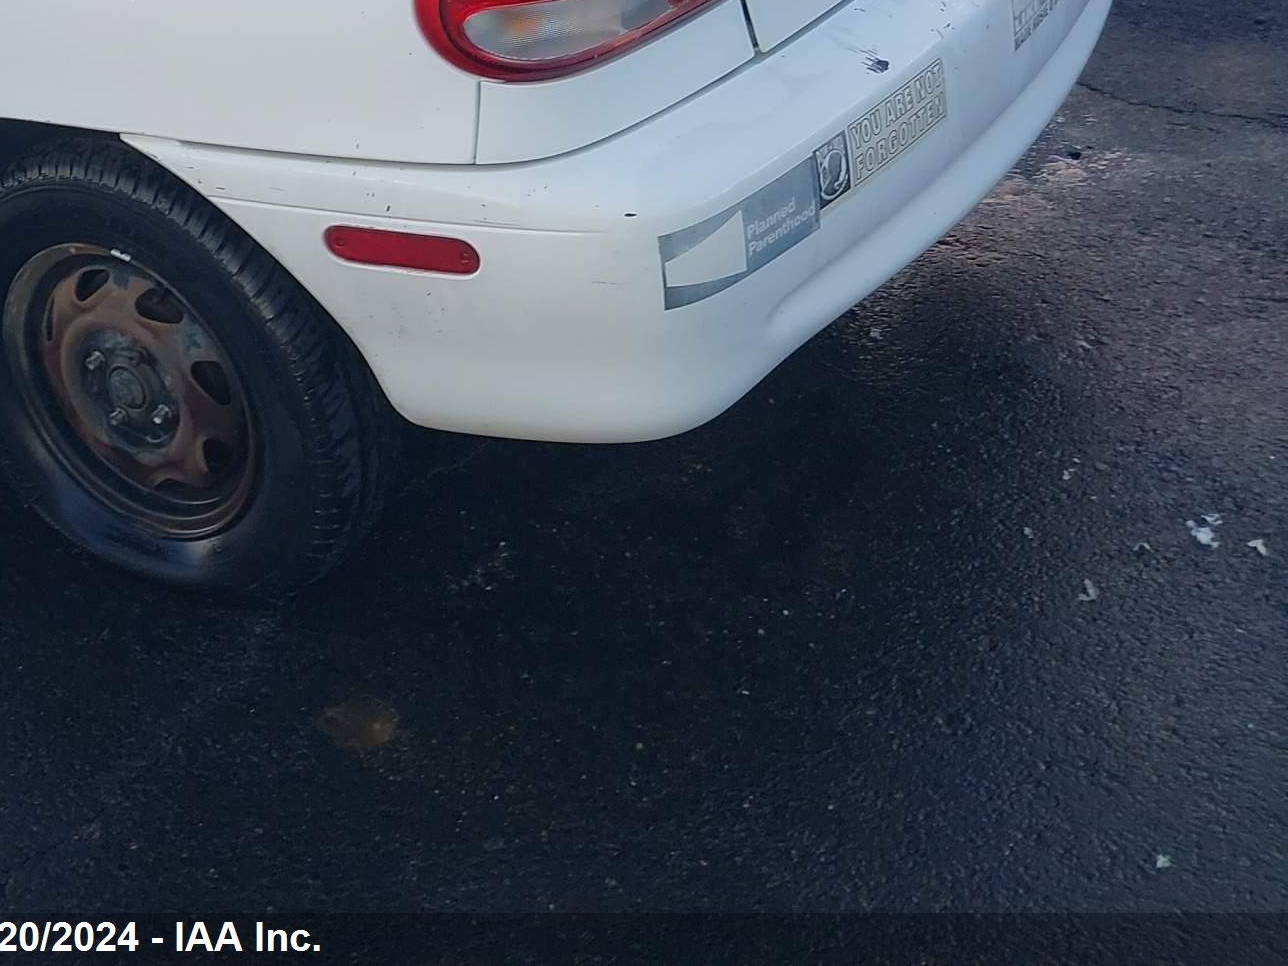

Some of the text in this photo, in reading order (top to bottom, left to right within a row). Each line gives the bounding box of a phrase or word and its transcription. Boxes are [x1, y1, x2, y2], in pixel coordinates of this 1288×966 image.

[850, 108, 882, 150] YOU
[884, 84, 913, 128] ARE
[913, 65, 944, 104] NOT
[855, 91, 945, 181] FORGOTTEN
[746, 196, 796, 240] Planned
[748, 199, 816, 256] Parenthood
